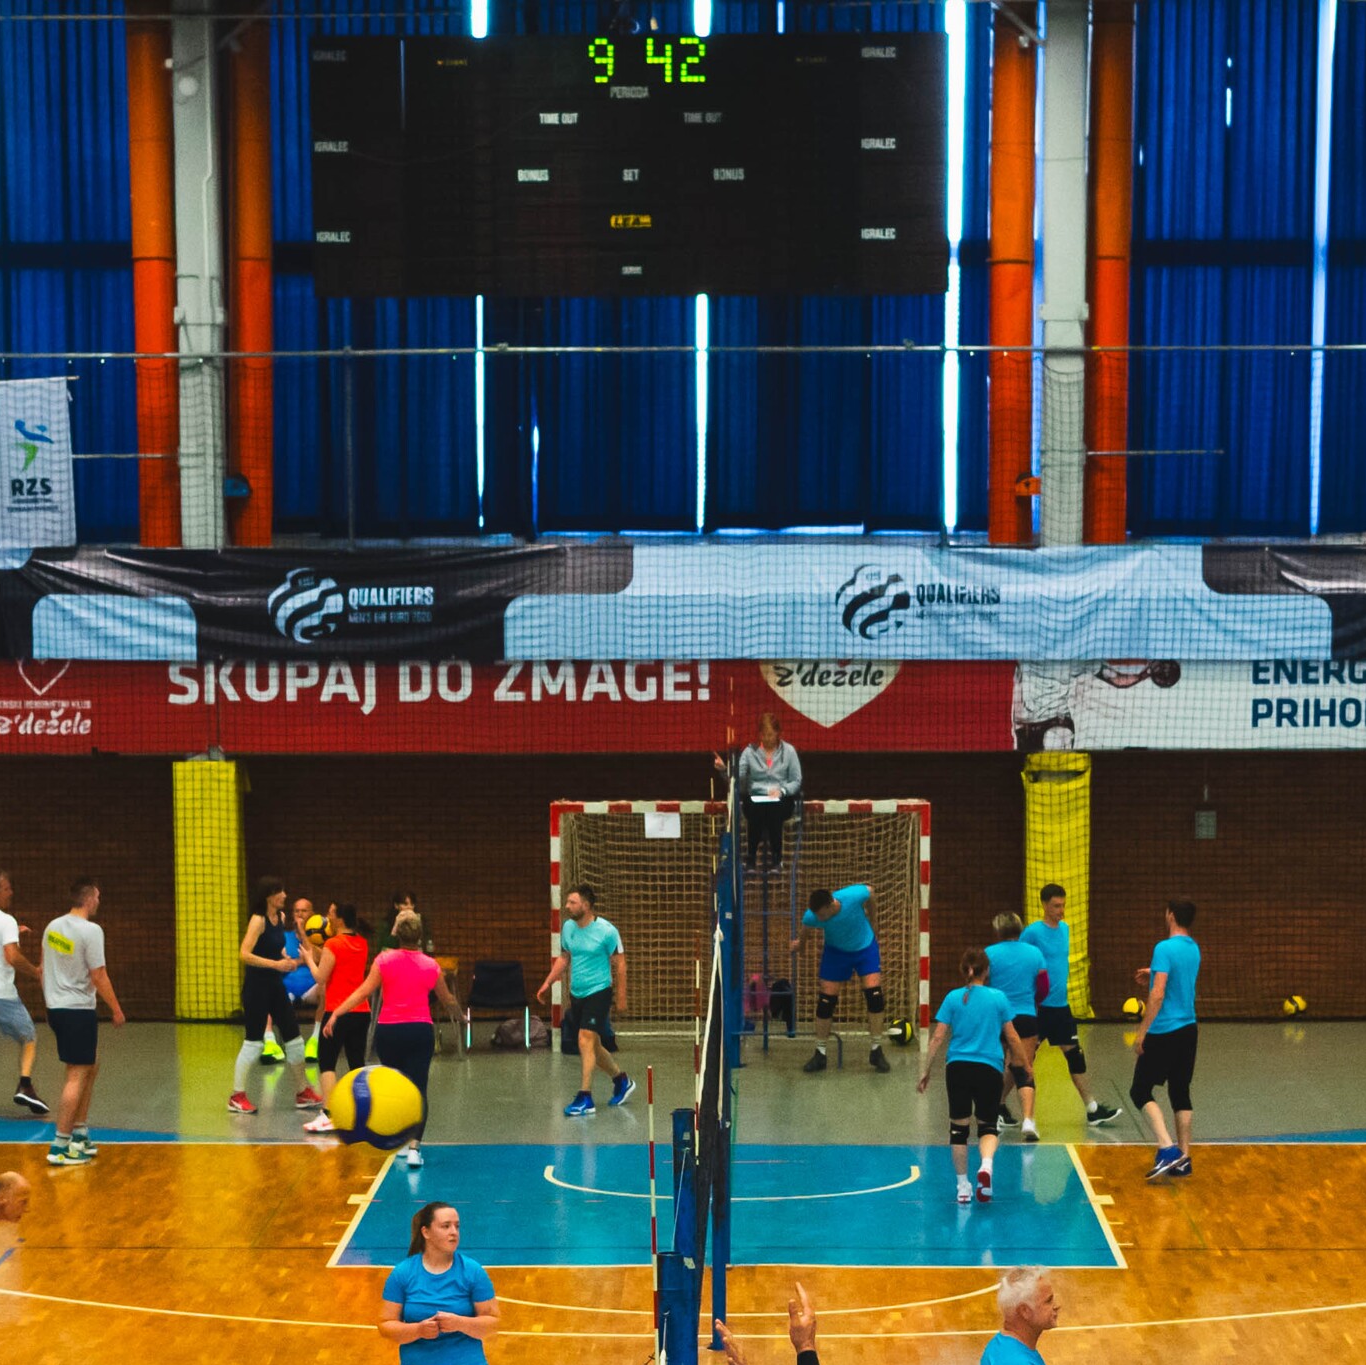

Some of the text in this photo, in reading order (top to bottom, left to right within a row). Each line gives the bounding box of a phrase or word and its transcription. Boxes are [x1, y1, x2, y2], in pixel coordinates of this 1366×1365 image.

[588, 37, 706, 83] 9 42
[539, 112, 578, 124] TIME OUT
[314, 140, 349, 152] IGRALEC
[861, 137, 896, 149] IGRALEC
[517, 169, 549, 182] BONUS
[622, 168, 640, 181] SET
[713, 167, 745, 180] BONUS
[316, 230, 351, 243] IGRALEC
[861, 228, 896, 240] IGRALEC
[11, 478, 52, 496] RZS
[348, 586, 434, 609] QUALIFIERS
[916, 583, 1001, 606] QUALIFIERS
[168, 660, 710, 716] SKUPAJ DO ZMAGE!
